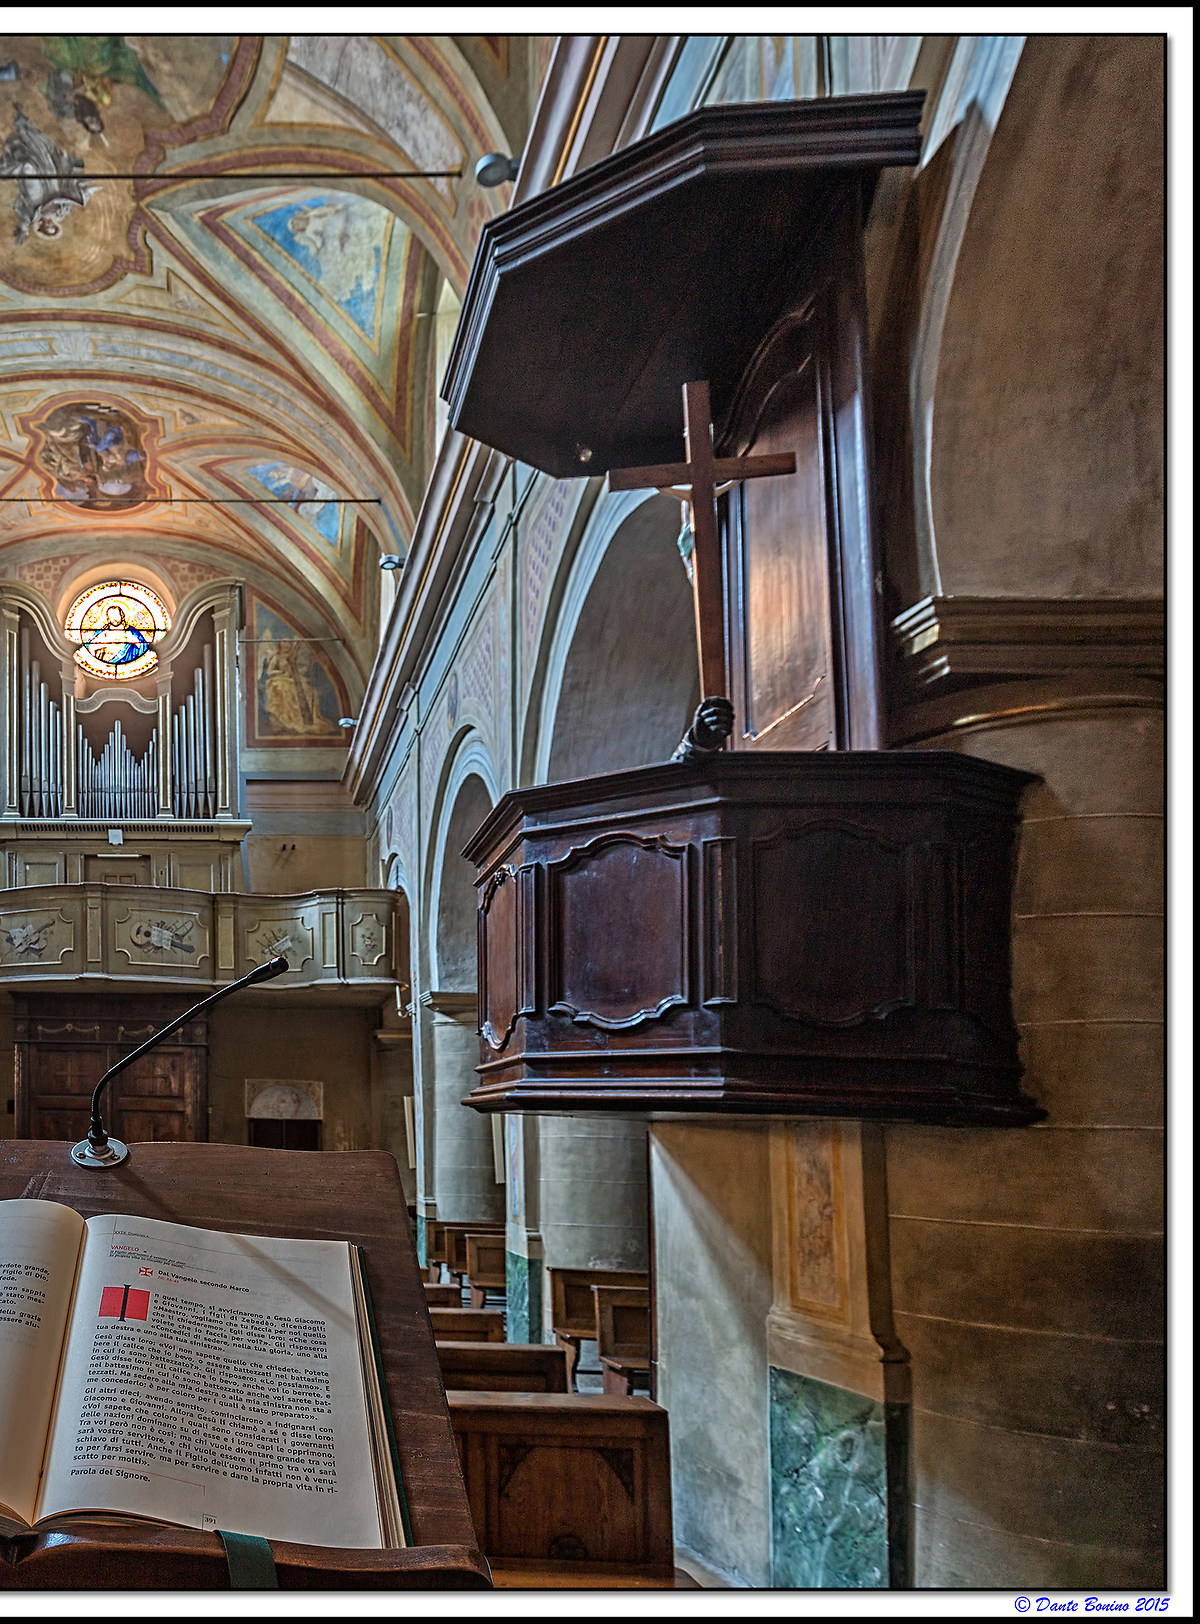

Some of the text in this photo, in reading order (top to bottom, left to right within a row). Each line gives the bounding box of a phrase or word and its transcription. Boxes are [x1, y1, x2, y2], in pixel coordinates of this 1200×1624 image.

[21, 1288, 45, 1298] sappia
[171, 1273, 198, 1283] Vangelo
[200, 1280, 227, 1289] secondo
[19, 1312, 41, 1321] grazia
[218, 1306, 263, 1318] avvicinarono
[294, 1317, 325, 1325] Giacomo
[115, 1333, 135, 1341] disse
[159, 1341, 175, 1350] «Voi
[196, 1351, 220, 1361] sapete
[223, 1357, 246, 1366] quello
[304, 1368, 328, 1377] Potete
[119, 1388, 141, 1398] dieci,
[145, 1394, 173, 1404] avendo
[176, 1401, 206, 1414] sentito,
[210, 1409, 263, 1425] cominciarono
[275, 1421, 315, 1432] indignarsi
[152, 1411, 177, 1421] coloro
[188, 1420, 208, 1429] quali
[212, 1426, 230, 1434] sono
[234, 1431, 279, 1444] considerati
[290, 1440, 334, 1449] governanti
[122, 1438, 143, 1447] tutti.
[147, 1442, 172, 1454] Anche
[185, 1451, 208, 1462] Figlio
[211, 1458, 252, 1472] dell’uomo
[255, 1467, 282, 1478] infatti
[125, 1449, 155, 1460] servire,
[191, 1463, 219, 1474] servire
[230, 1471, 248, 1480] dare
[262, 1479, 292, 1488] propria
[115, 1470, 150, 1481] Signore.
